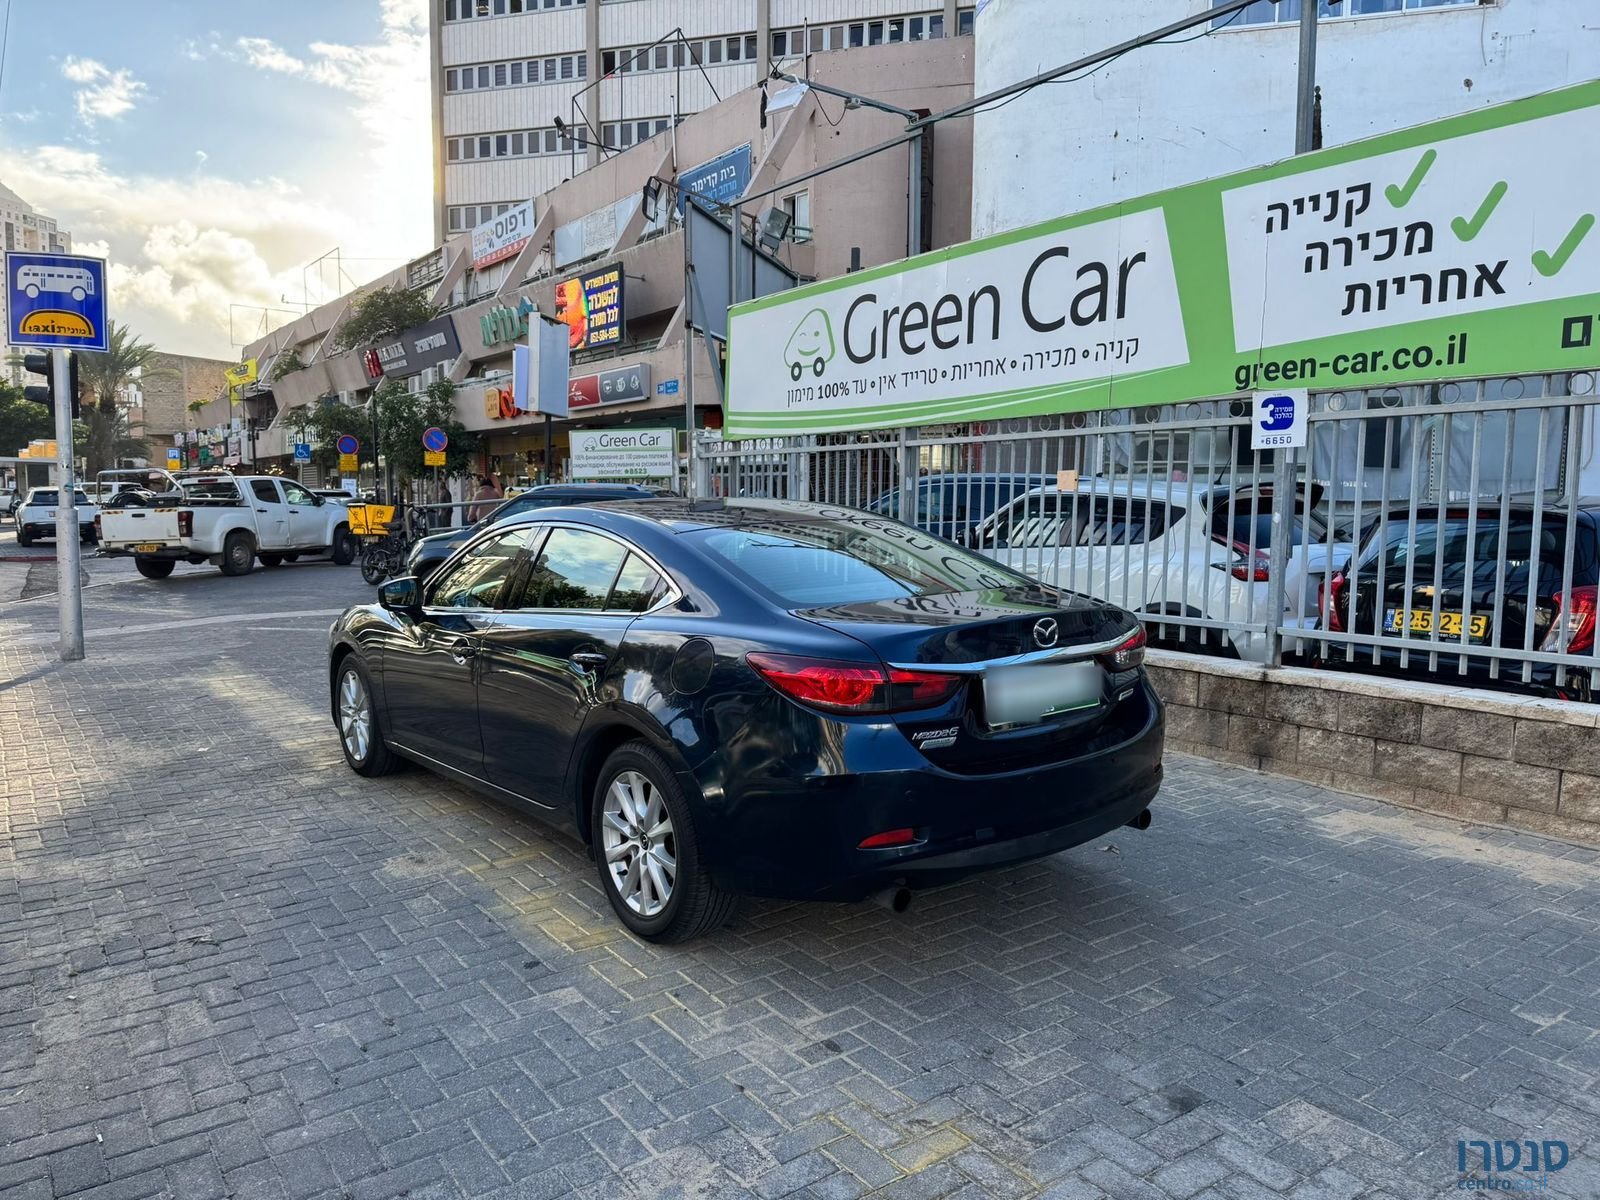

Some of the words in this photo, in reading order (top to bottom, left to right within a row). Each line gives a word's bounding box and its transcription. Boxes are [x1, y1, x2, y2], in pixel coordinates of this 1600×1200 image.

[691, 173, 718, 193] קדימה
[720, 165, 736, 181] בית
[1265, 182, 1372, 234] קנייה
[495, 209, 527, 239] דפוס
[1304, 221, 1434, 273] מכירה
[1341, 260, 1509, 316] אחריות
[843, 285, 1000, 364] Green
[1021, 246, 1146, 333] Car
[28, 320, 56, 333] taxi
[56, 325, 87, 335] מונית
[1022, 347, 1076, 372] מכירה
[1095, 337, 1139, 364] קניה
[1234, 332, 1468, 391] green-car.co.il
[901, 368, 938, 387] טרייד
[950, 357, 1007, 381] אחריות
[817, 382, 850, 400] 100%
[852, 380, 868, 395] עד
[878, 374, 897, 396] אין
[786, 387, 814, 408] מימון
[599, 434, 636, 448] Green
[639, 432, 661, 446] Car
